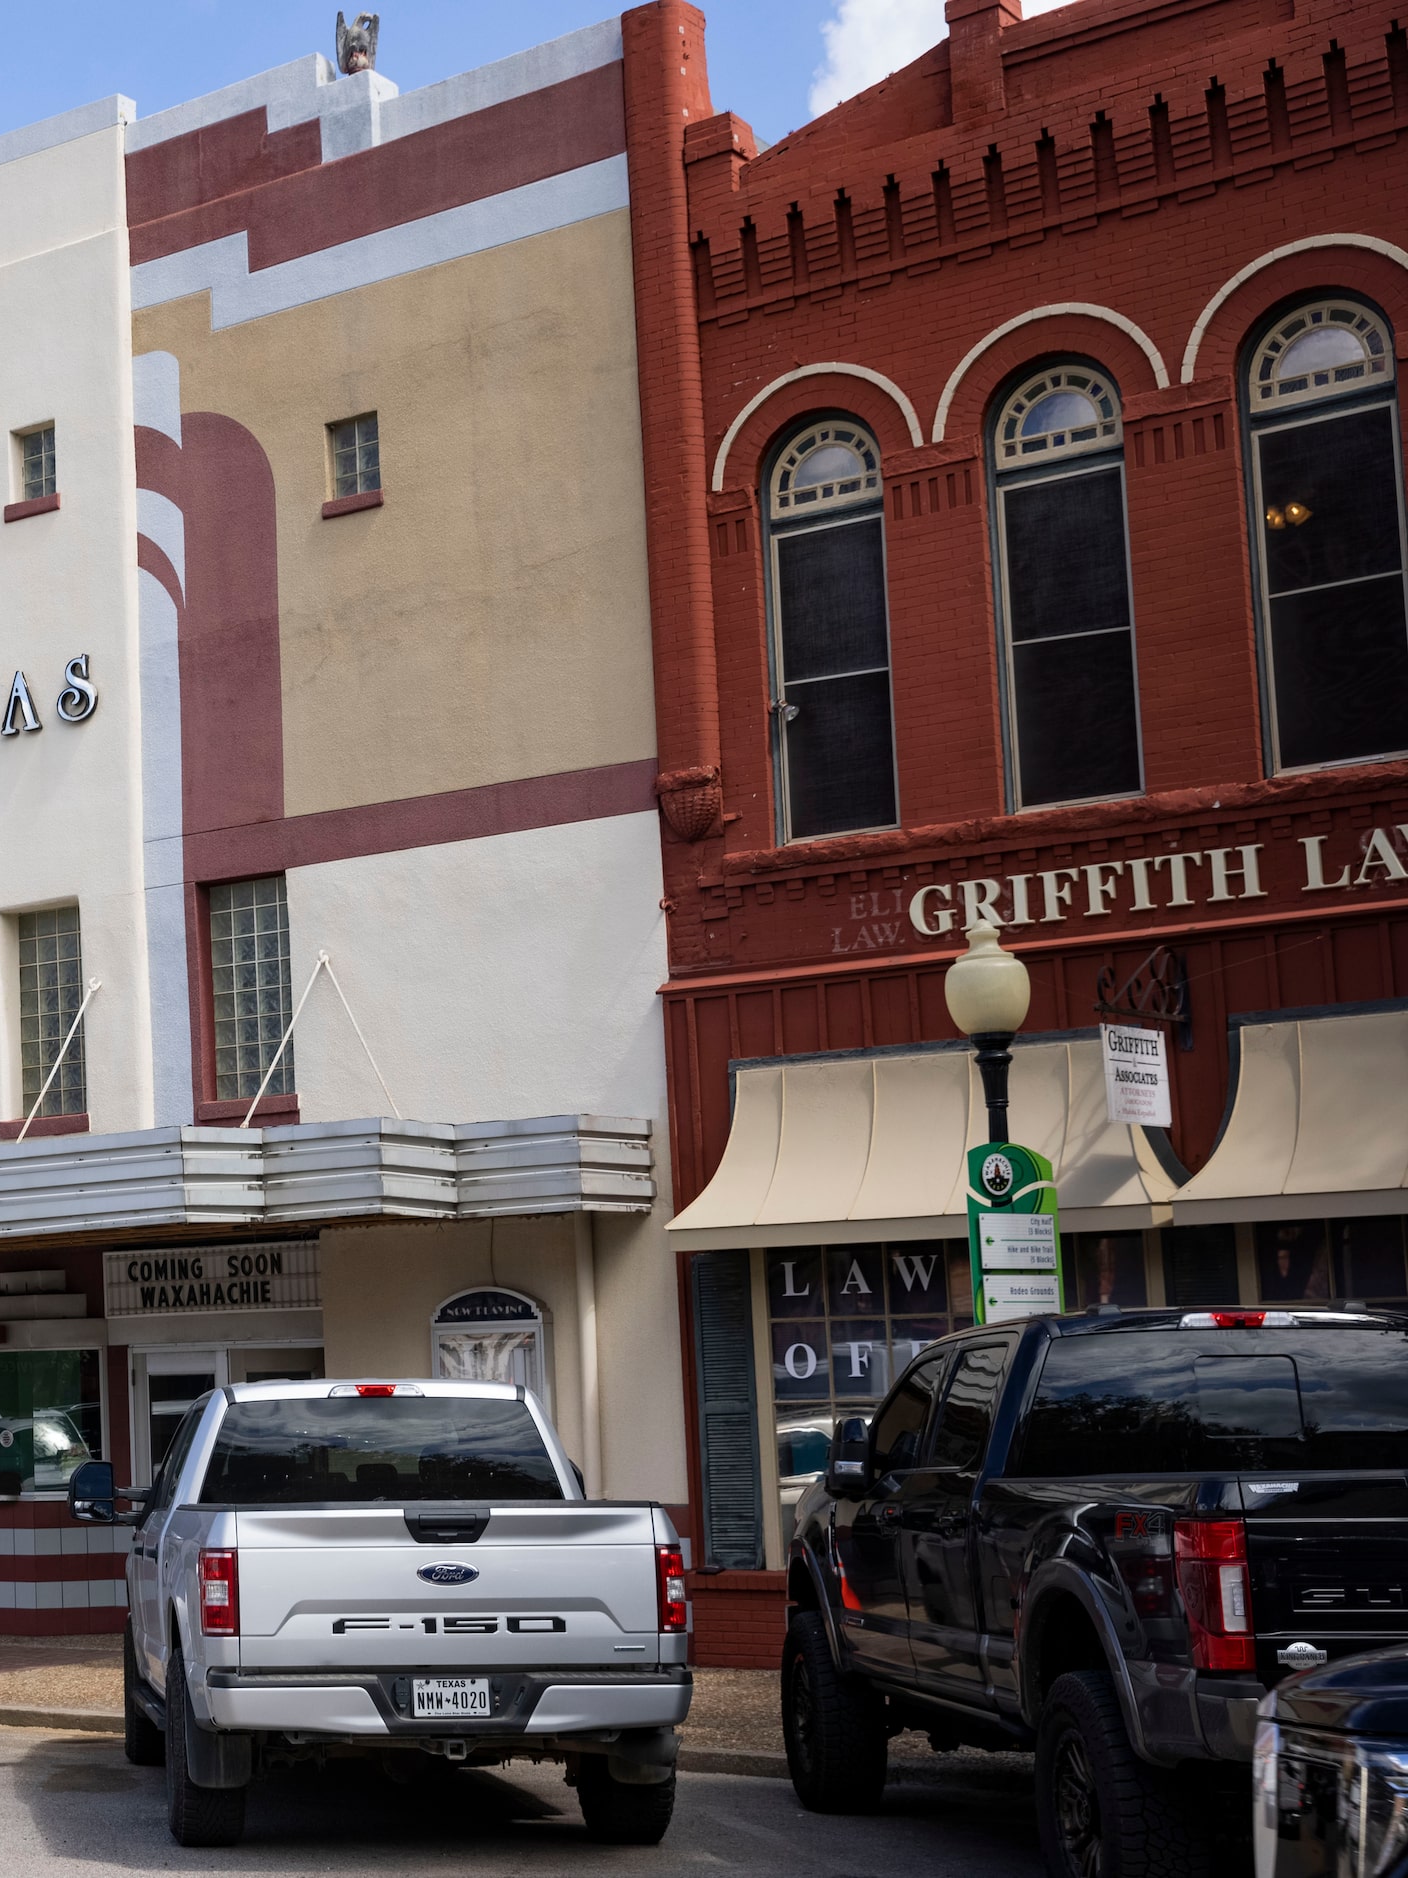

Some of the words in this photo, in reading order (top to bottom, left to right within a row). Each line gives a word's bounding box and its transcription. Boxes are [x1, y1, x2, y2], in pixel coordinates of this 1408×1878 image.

[908, 843, 1269, 937] GRIFFITH
[1296, 823, 1408, 892] LA
[1108, 1030, 1159, 1057] GRIFFITH
[1114, 1066, 1158, 1086] ASSOCIATES
[1030, 1218, 1041, 1226] City
[1041, 1218, 1052, 1226] Hall
[1007, 1246, 1019, 1254] Hike
[1042, 1246, 1054, 1254] Trail
[127, 1257, 204, 1282] COMING
[227, 1252, 283, 1278] SOON
[780, 1254, 939, 1297] LAW
[140, 1280, 272, 1308] WAXAHACHIE
[1010, 1287, 1029, 1296] Rodeo
[1030, 1287, 1055, 1296] Grounds
[446, 1305, 471, 1317] NOW
[475, 1303, 525, 1316] PLAYING
[1114, 1509, 1166, 1542] FX4
[431, 1565, 466, 1582] Ford
[332, 1615, 568, 1635] F-150
[436, 1680, 466, 1688] TEXAS
